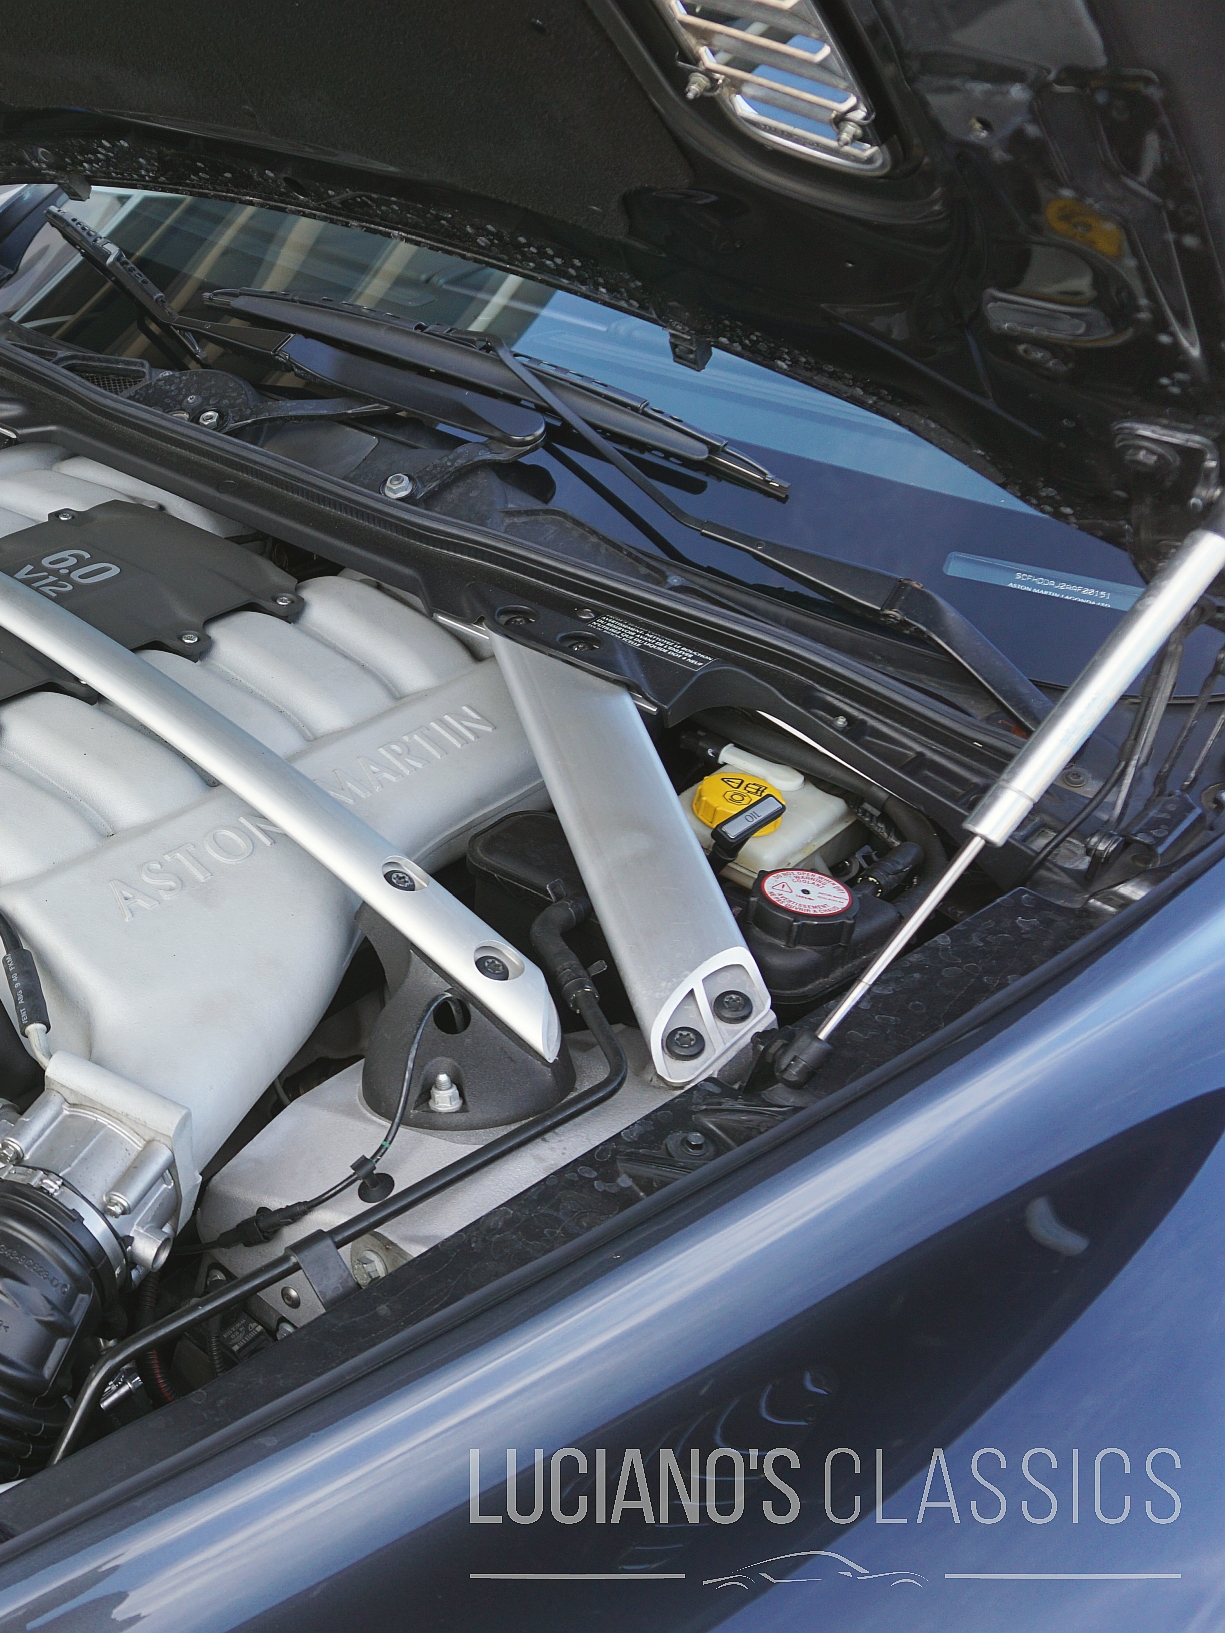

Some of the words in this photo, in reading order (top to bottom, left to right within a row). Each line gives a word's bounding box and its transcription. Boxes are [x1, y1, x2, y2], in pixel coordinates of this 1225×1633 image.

[41, 549, 121, 584] 6.0
[13, 564, 74, 597] V12
[1007, 583, 1032, 591] ASTON
[1032, 588, 1060, 598] MARTIN
[109, 816, 284, 921] ASTON
[313, 704, 497, 804] MARTIN
[745, 811, 763, 823] OIL
[792, 878, 825, 888] COOLANT
[793, 875, 828, 886] WARNING
